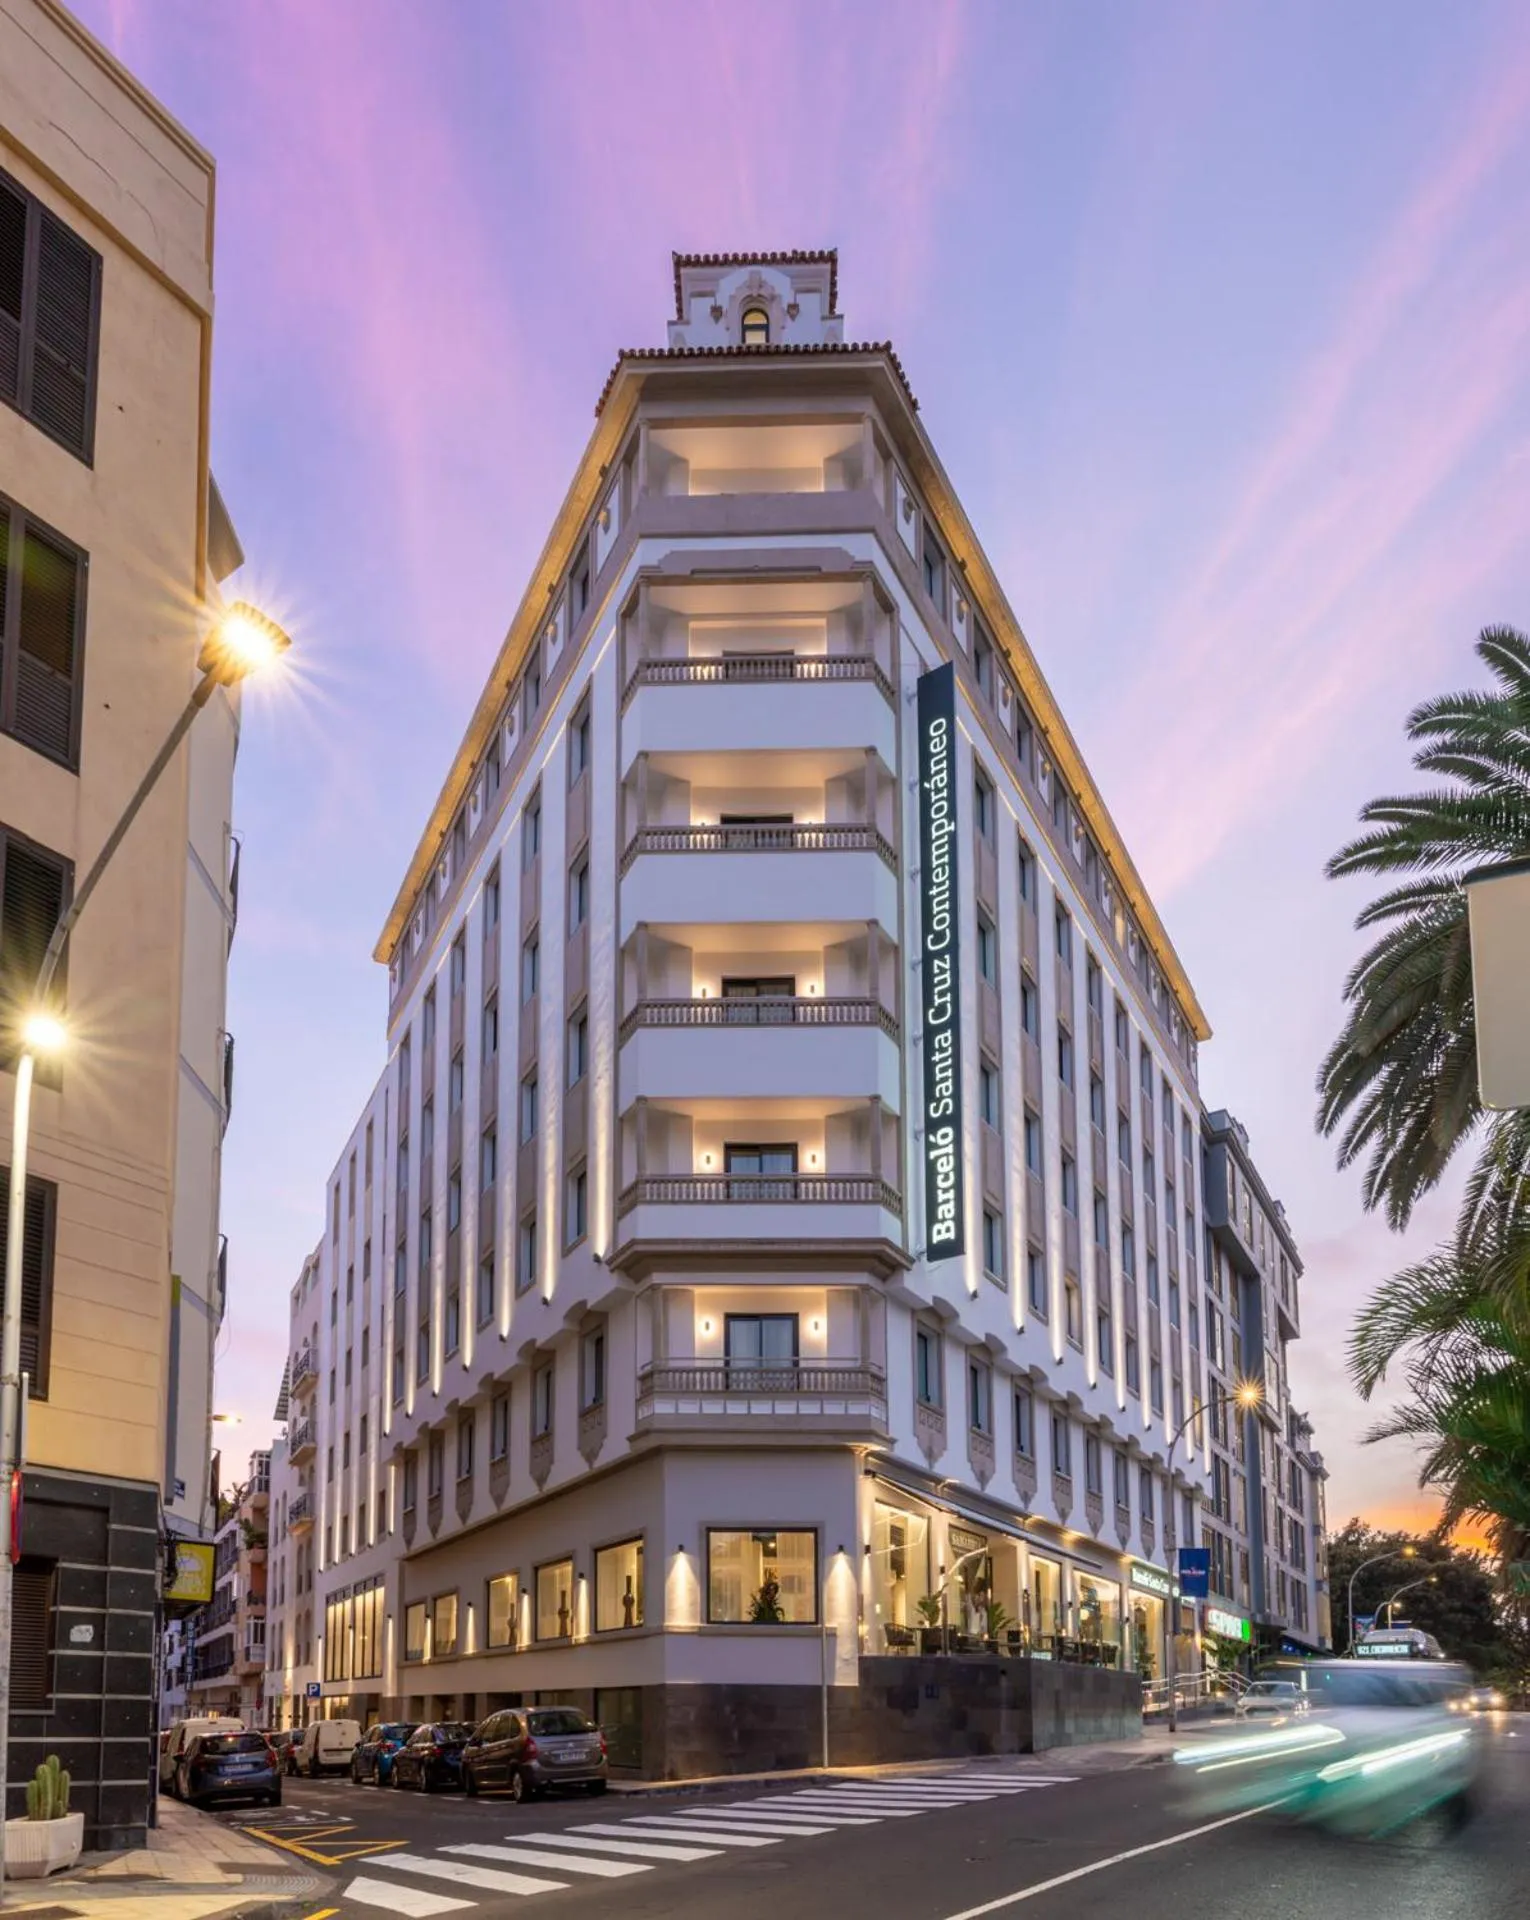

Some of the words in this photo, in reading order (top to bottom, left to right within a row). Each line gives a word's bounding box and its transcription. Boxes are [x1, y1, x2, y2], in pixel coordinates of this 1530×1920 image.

[924, 717, 955, 951] Contemporáneo
[928, 954, 951, 1026] Cruz
[930, 1029, 953, 1118] Santa
[929, 1126, 955, 1244] Barceló
[309, 1684, 318, 1696] P
